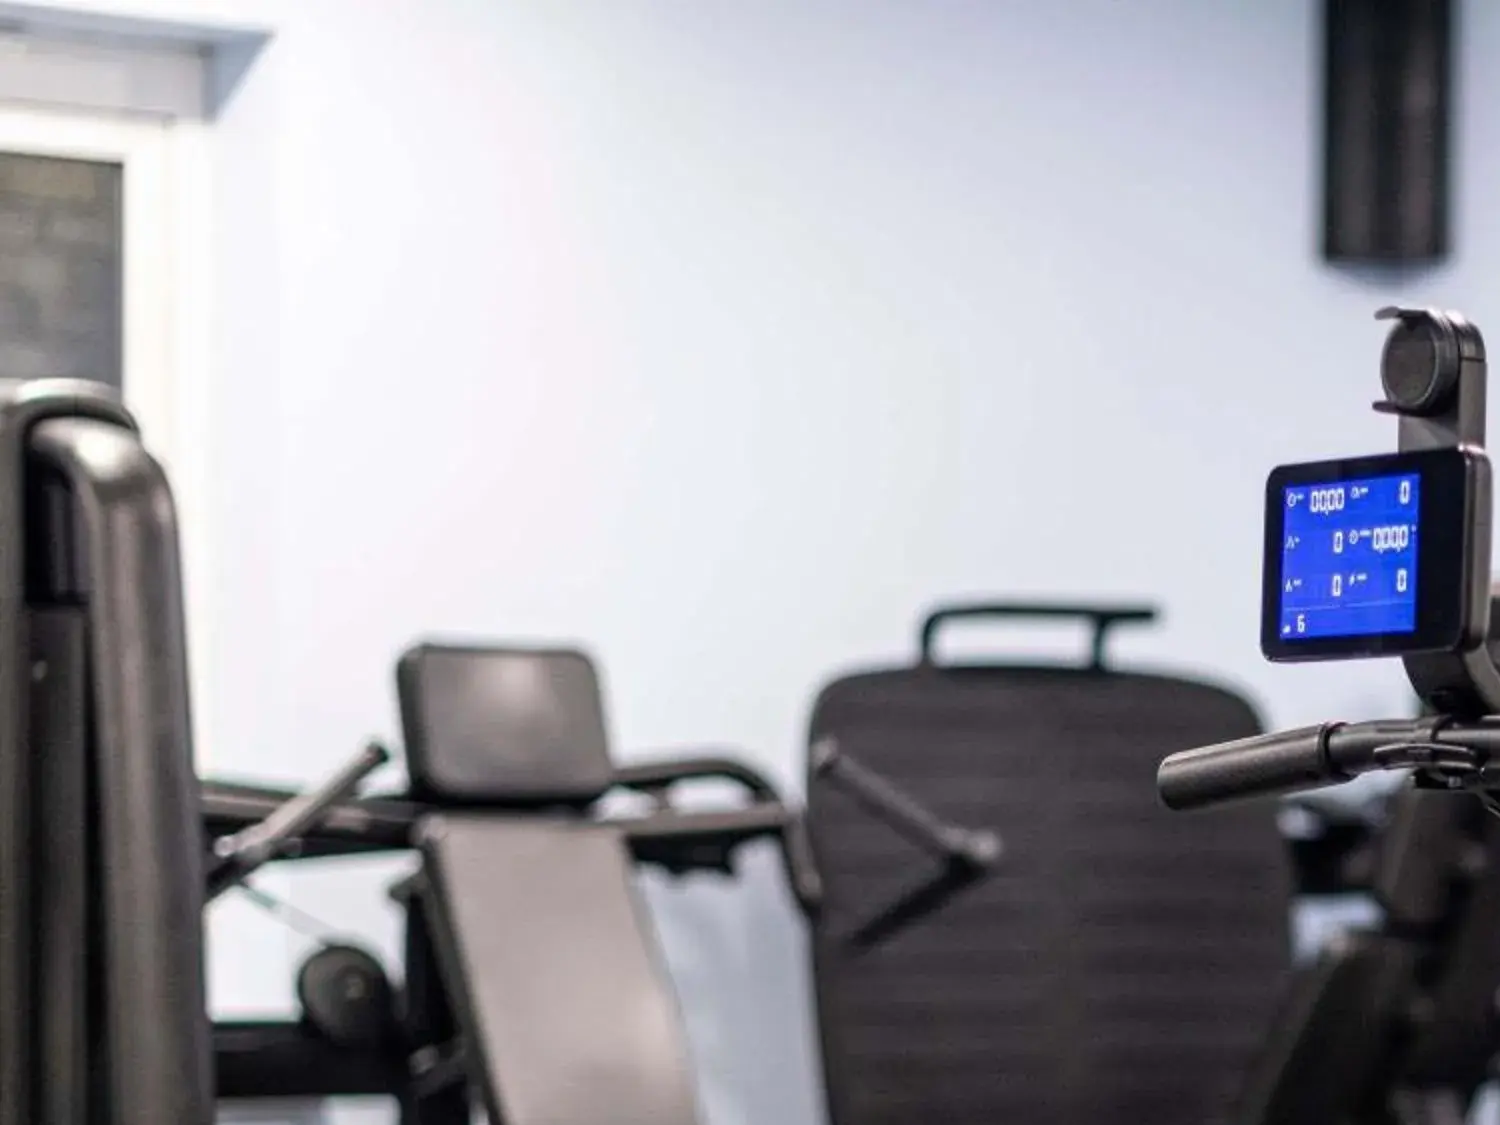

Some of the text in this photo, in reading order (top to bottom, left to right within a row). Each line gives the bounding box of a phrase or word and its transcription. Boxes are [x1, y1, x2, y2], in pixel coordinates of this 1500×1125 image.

[1400, 481, 1410, 504] 0
[1333, 531, 1343, 553] 0
[1332, 574, 1342, 597] 0
[1397, 569, 1407, 592] 0
